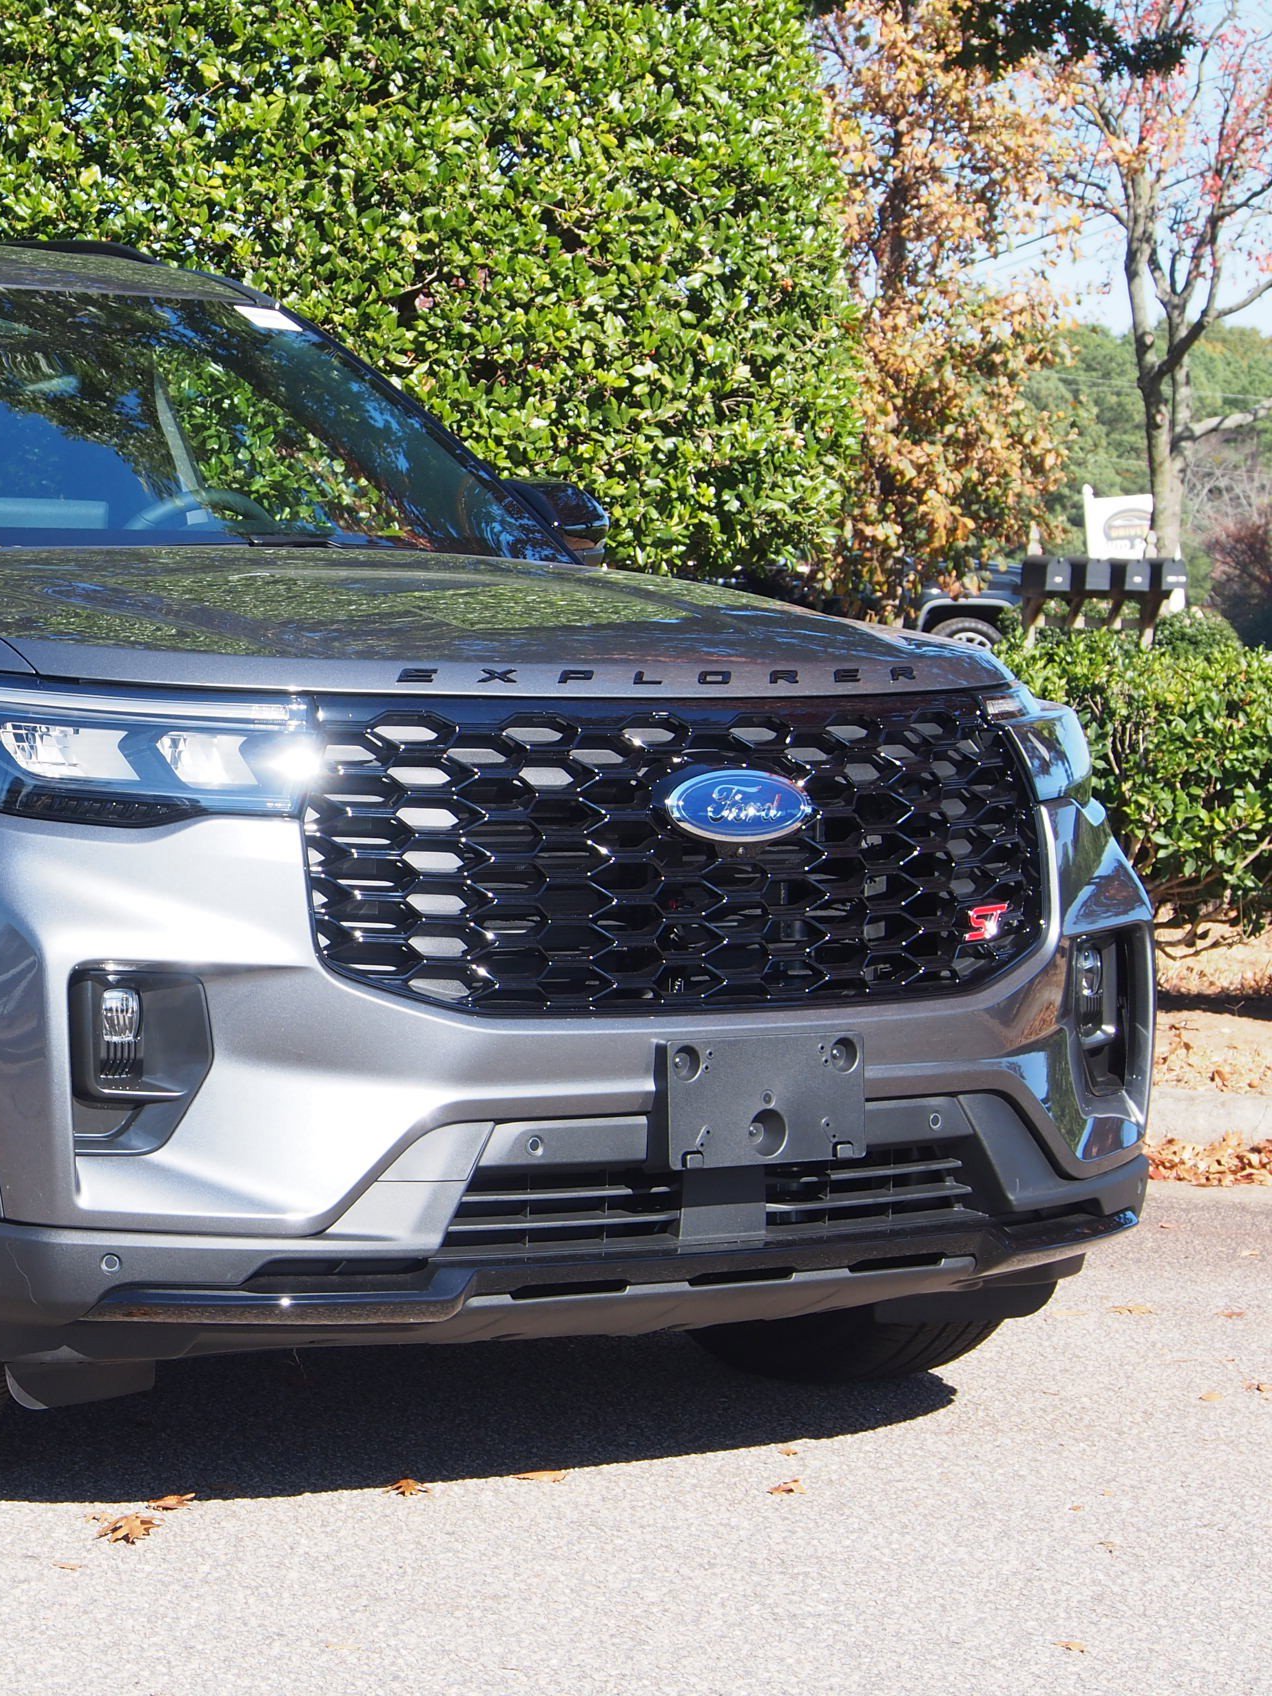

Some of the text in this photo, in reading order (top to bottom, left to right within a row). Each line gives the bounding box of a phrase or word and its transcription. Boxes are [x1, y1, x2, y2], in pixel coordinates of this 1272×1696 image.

[395, 665, 917, 686] EXPLORER
[706, 784, 782, 824] Ford
[964, 901, 1010, 941] ST
